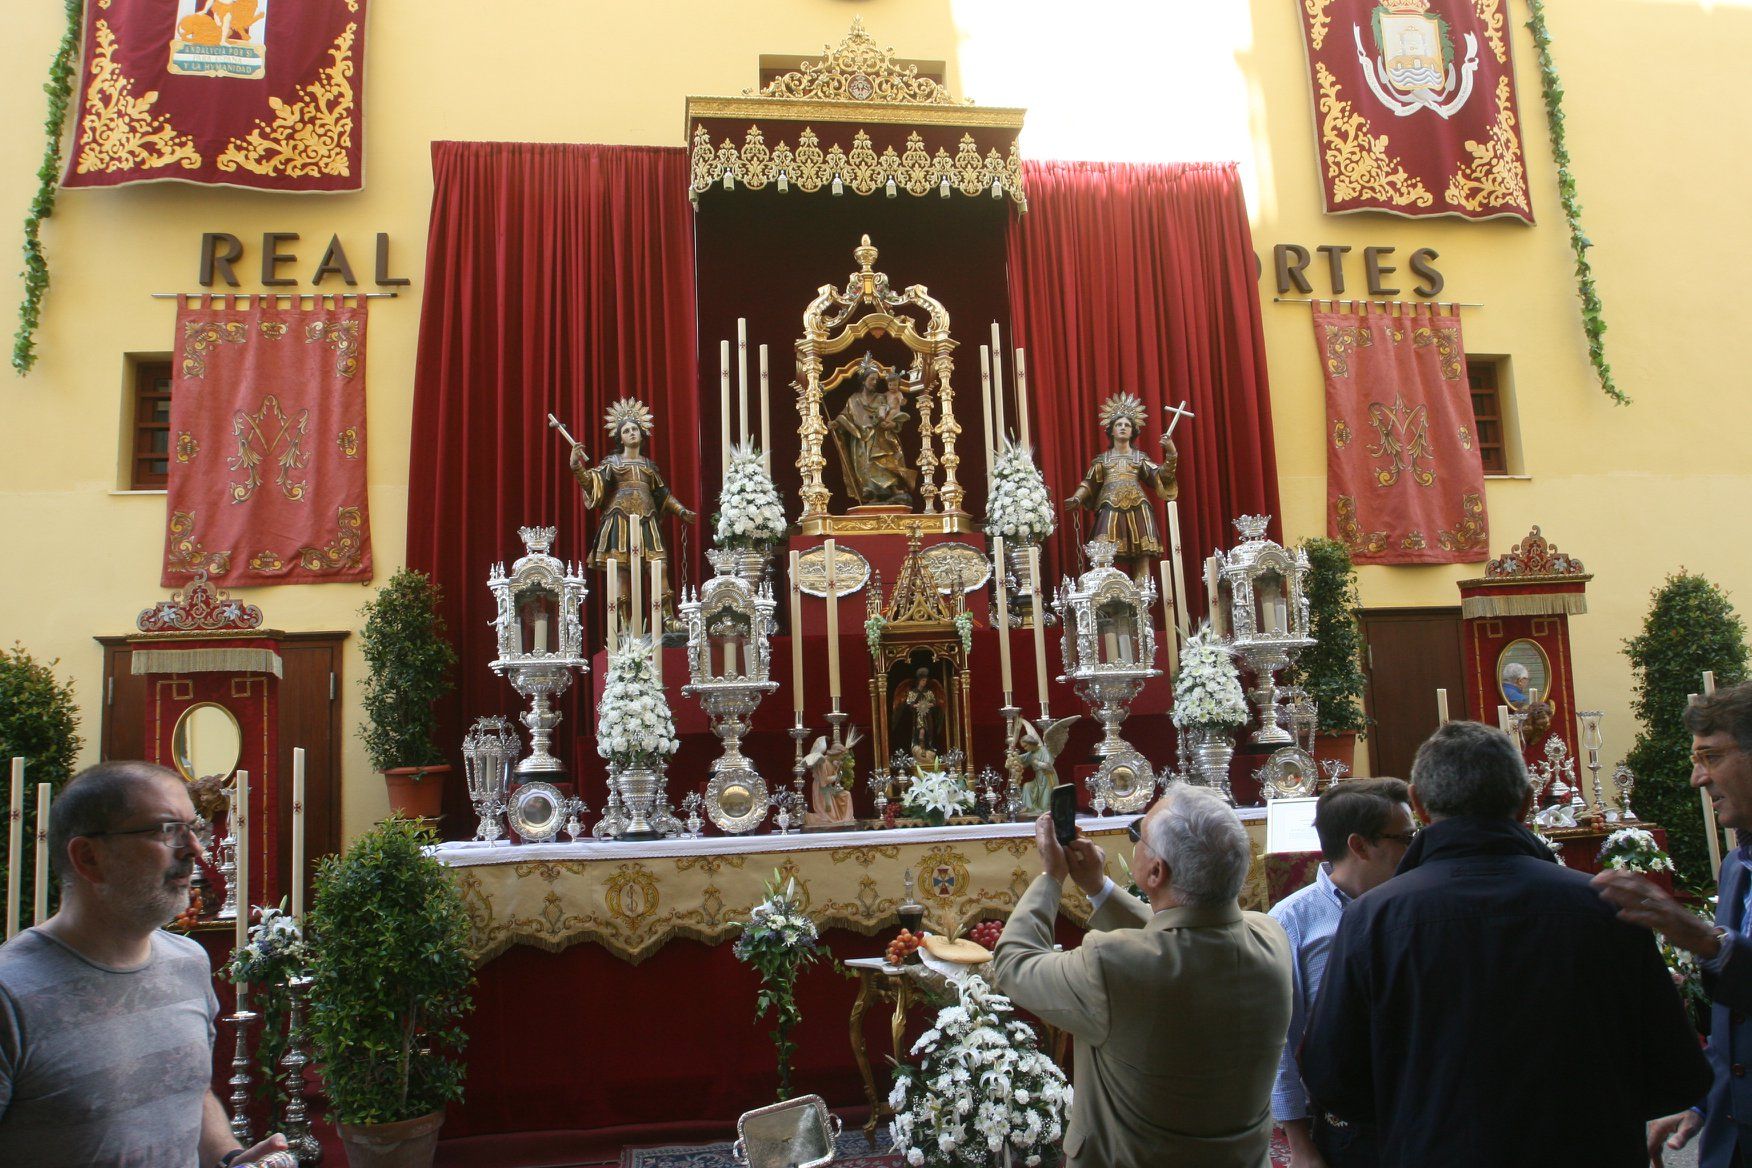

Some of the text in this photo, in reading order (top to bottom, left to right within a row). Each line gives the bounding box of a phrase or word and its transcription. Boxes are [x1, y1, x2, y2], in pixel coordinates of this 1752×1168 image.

[191, 62, 201, 71] LA
[229, 47, 243, 56] POR
[199, 232, 411, 287] REAL
[1253, 244, 1445, 298] RTES
